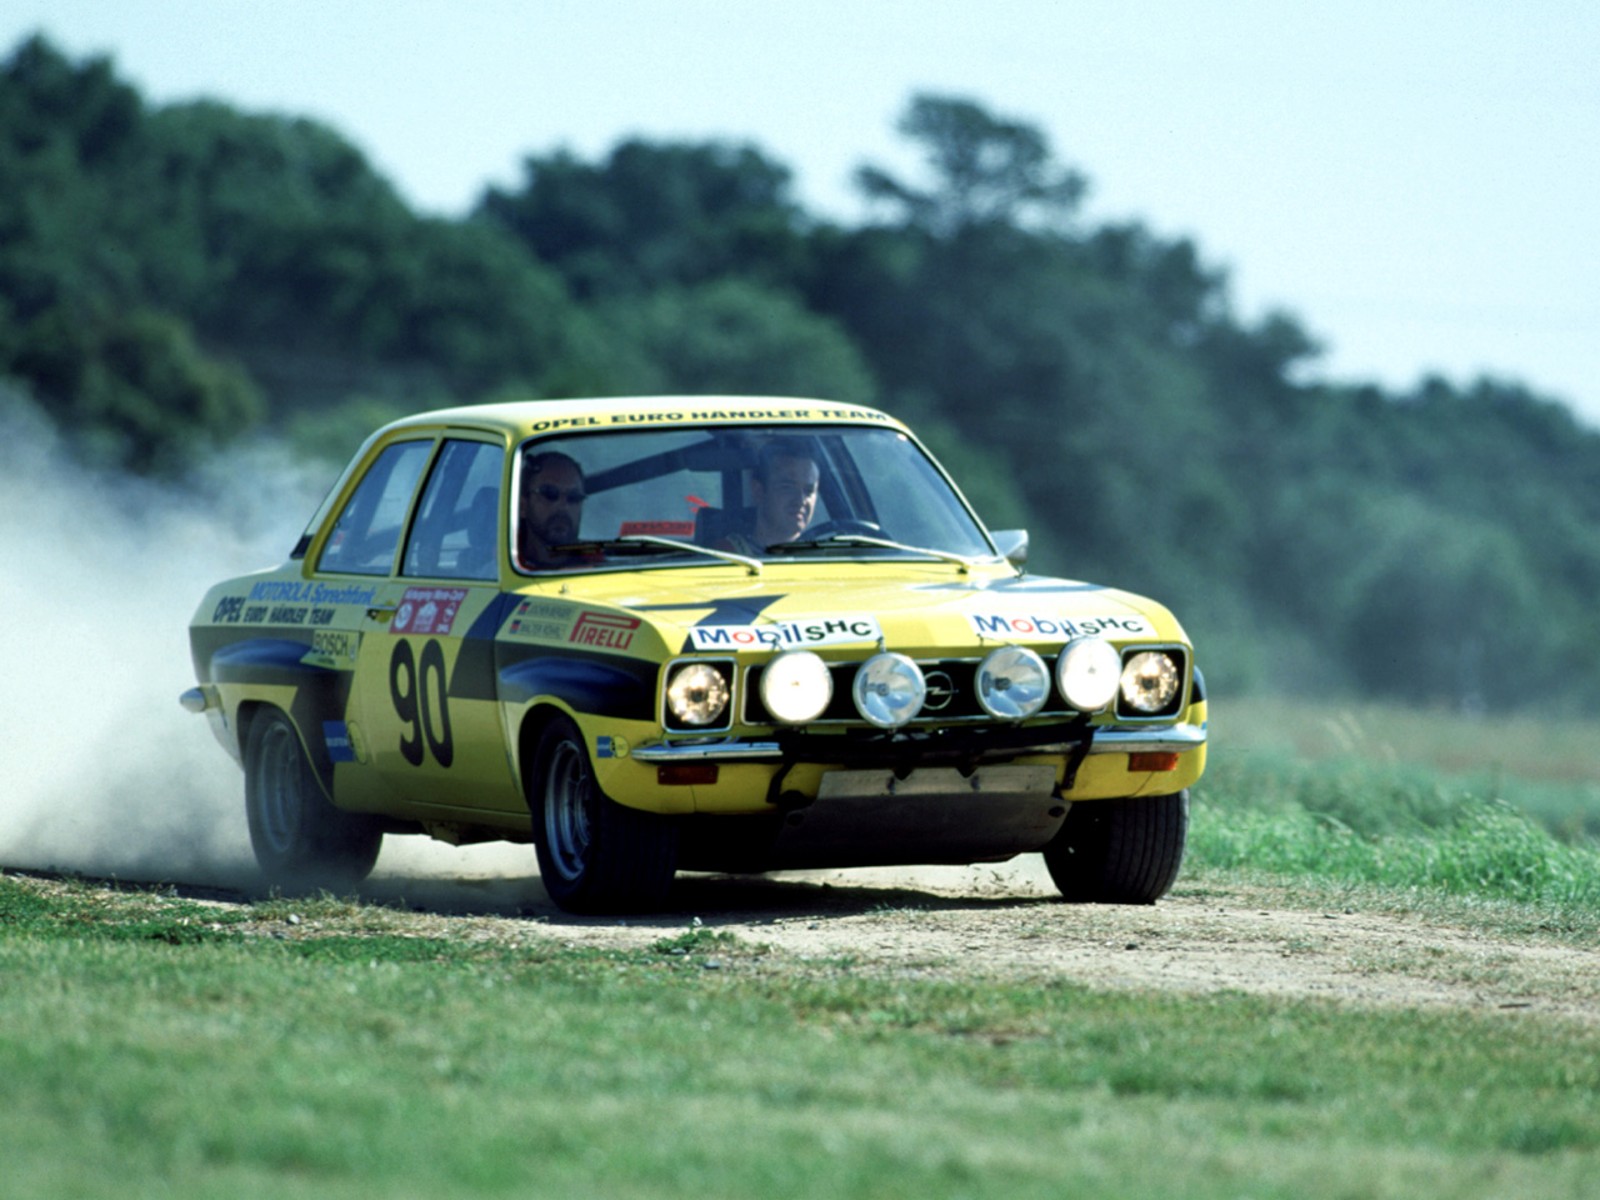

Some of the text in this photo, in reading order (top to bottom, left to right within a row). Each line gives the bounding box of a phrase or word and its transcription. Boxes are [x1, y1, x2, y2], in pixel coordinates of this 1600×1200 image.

[532, 416, 601, 431] OPEL
[610, 412, 684, 424] EURO
[817, 409, 887, 421] TEAM
[249, 581, 313, 602] MOTOROLA
[212, 596, 246, 624] OPEL
[243, 606, 268, 623] EURO
[308, 608, 336, 625] TEAM
[569, 611, 642, 650] PIRELLI
[312, 633, 349, 656] BOSCH
[390, 638, 453, 768] 90
